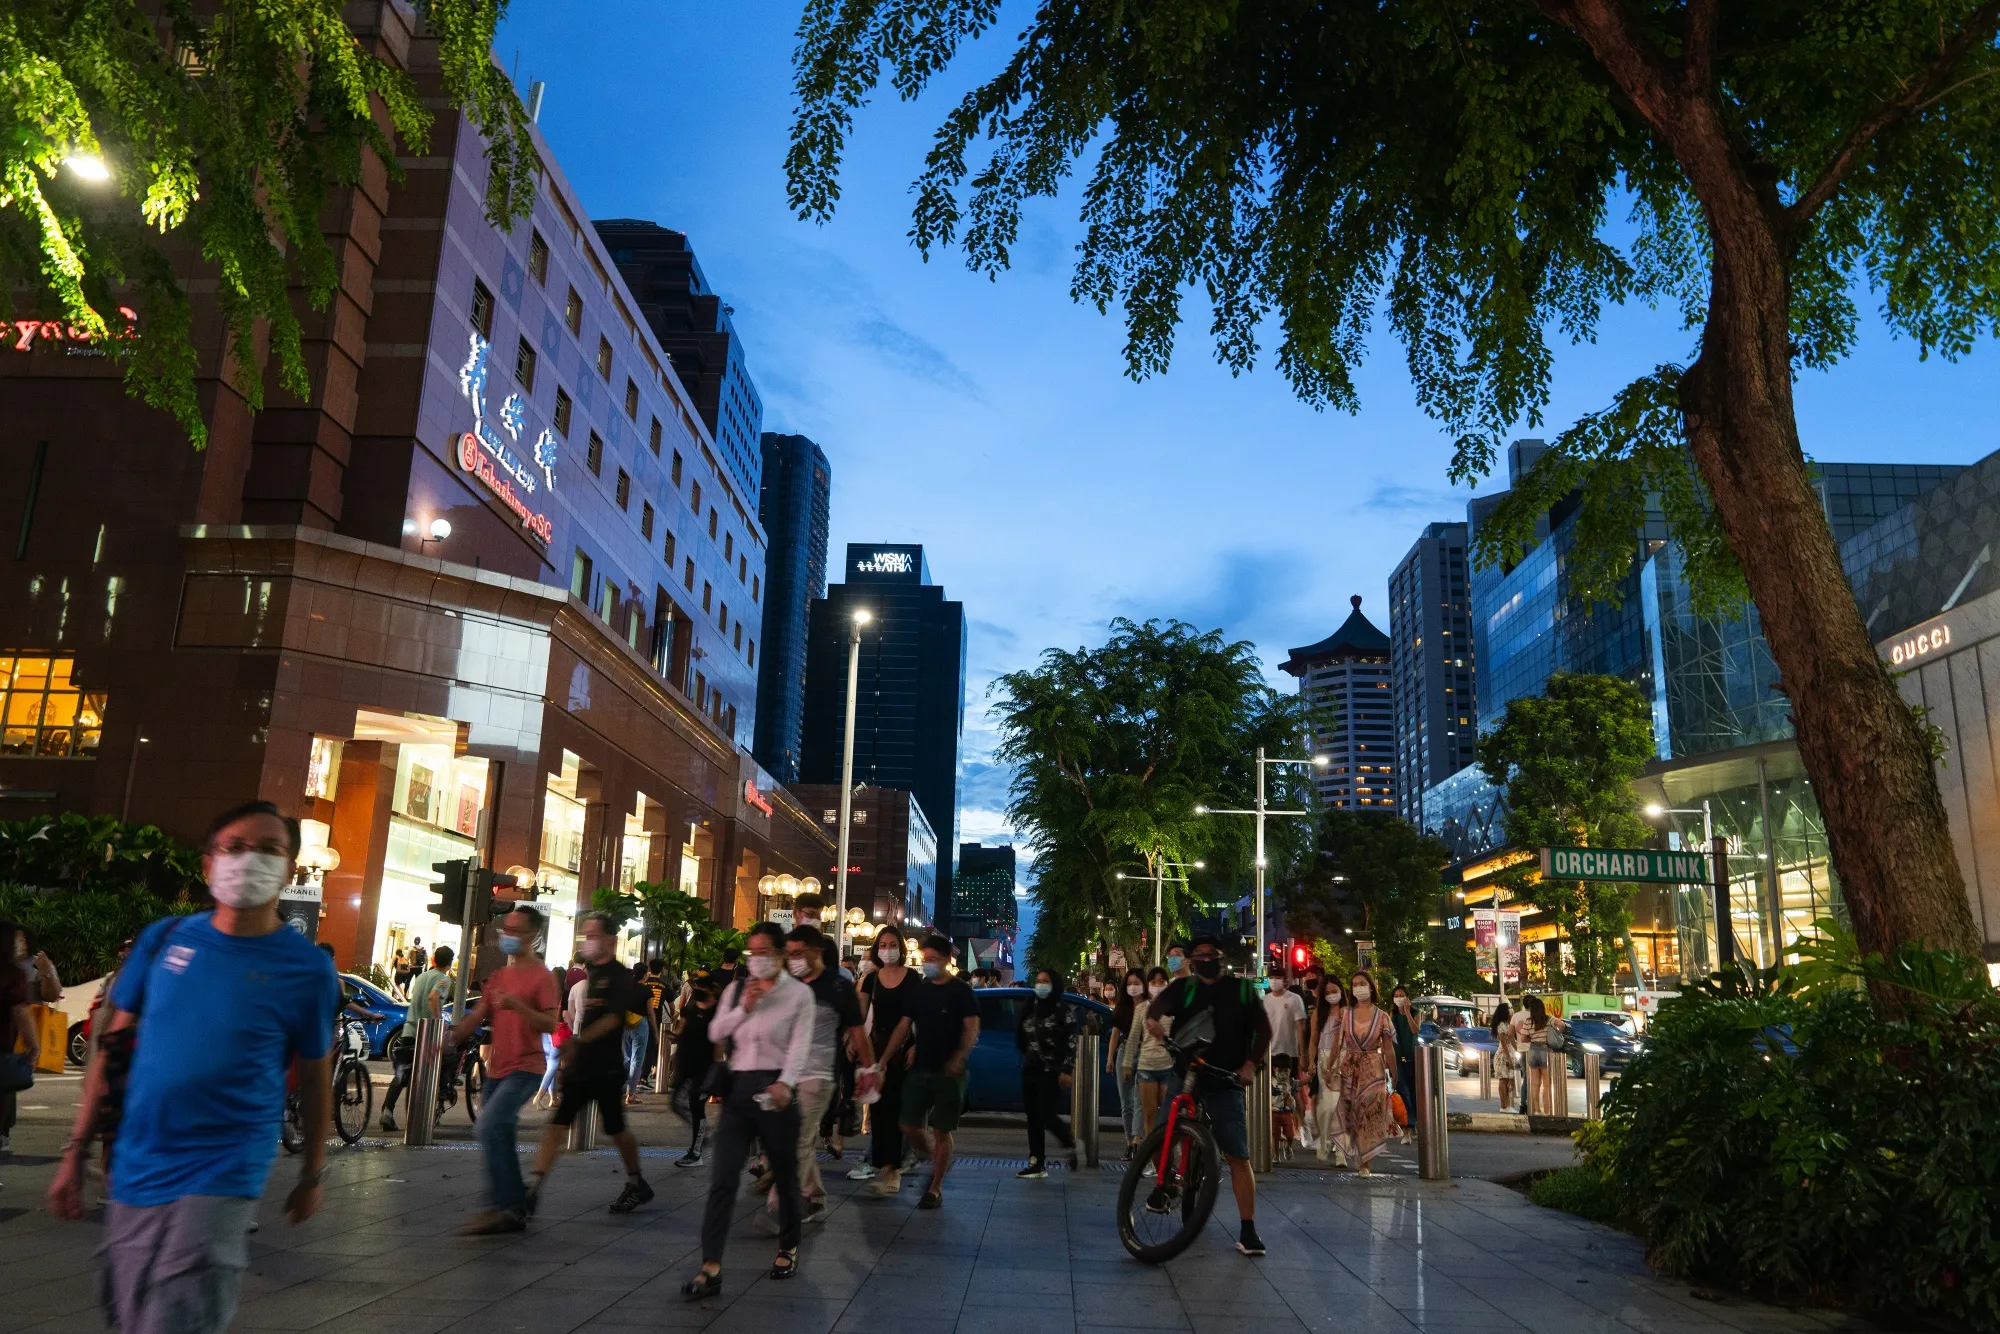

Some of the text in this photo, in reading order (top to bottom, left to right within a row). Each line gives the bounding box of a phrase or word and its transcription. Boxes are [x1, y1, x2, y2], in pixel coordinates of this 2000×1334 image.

[476, 450, 538, 529] Takashimaya
[873, 552, 913, 563] WISMA
[881, 562, 912, 573] ATRIA
[1891, 624, 1950, 665] GUCCI
[1555, 851, 1701, 879] ORCHARD LINK
[284, 888, 318, 896] CHANEL
